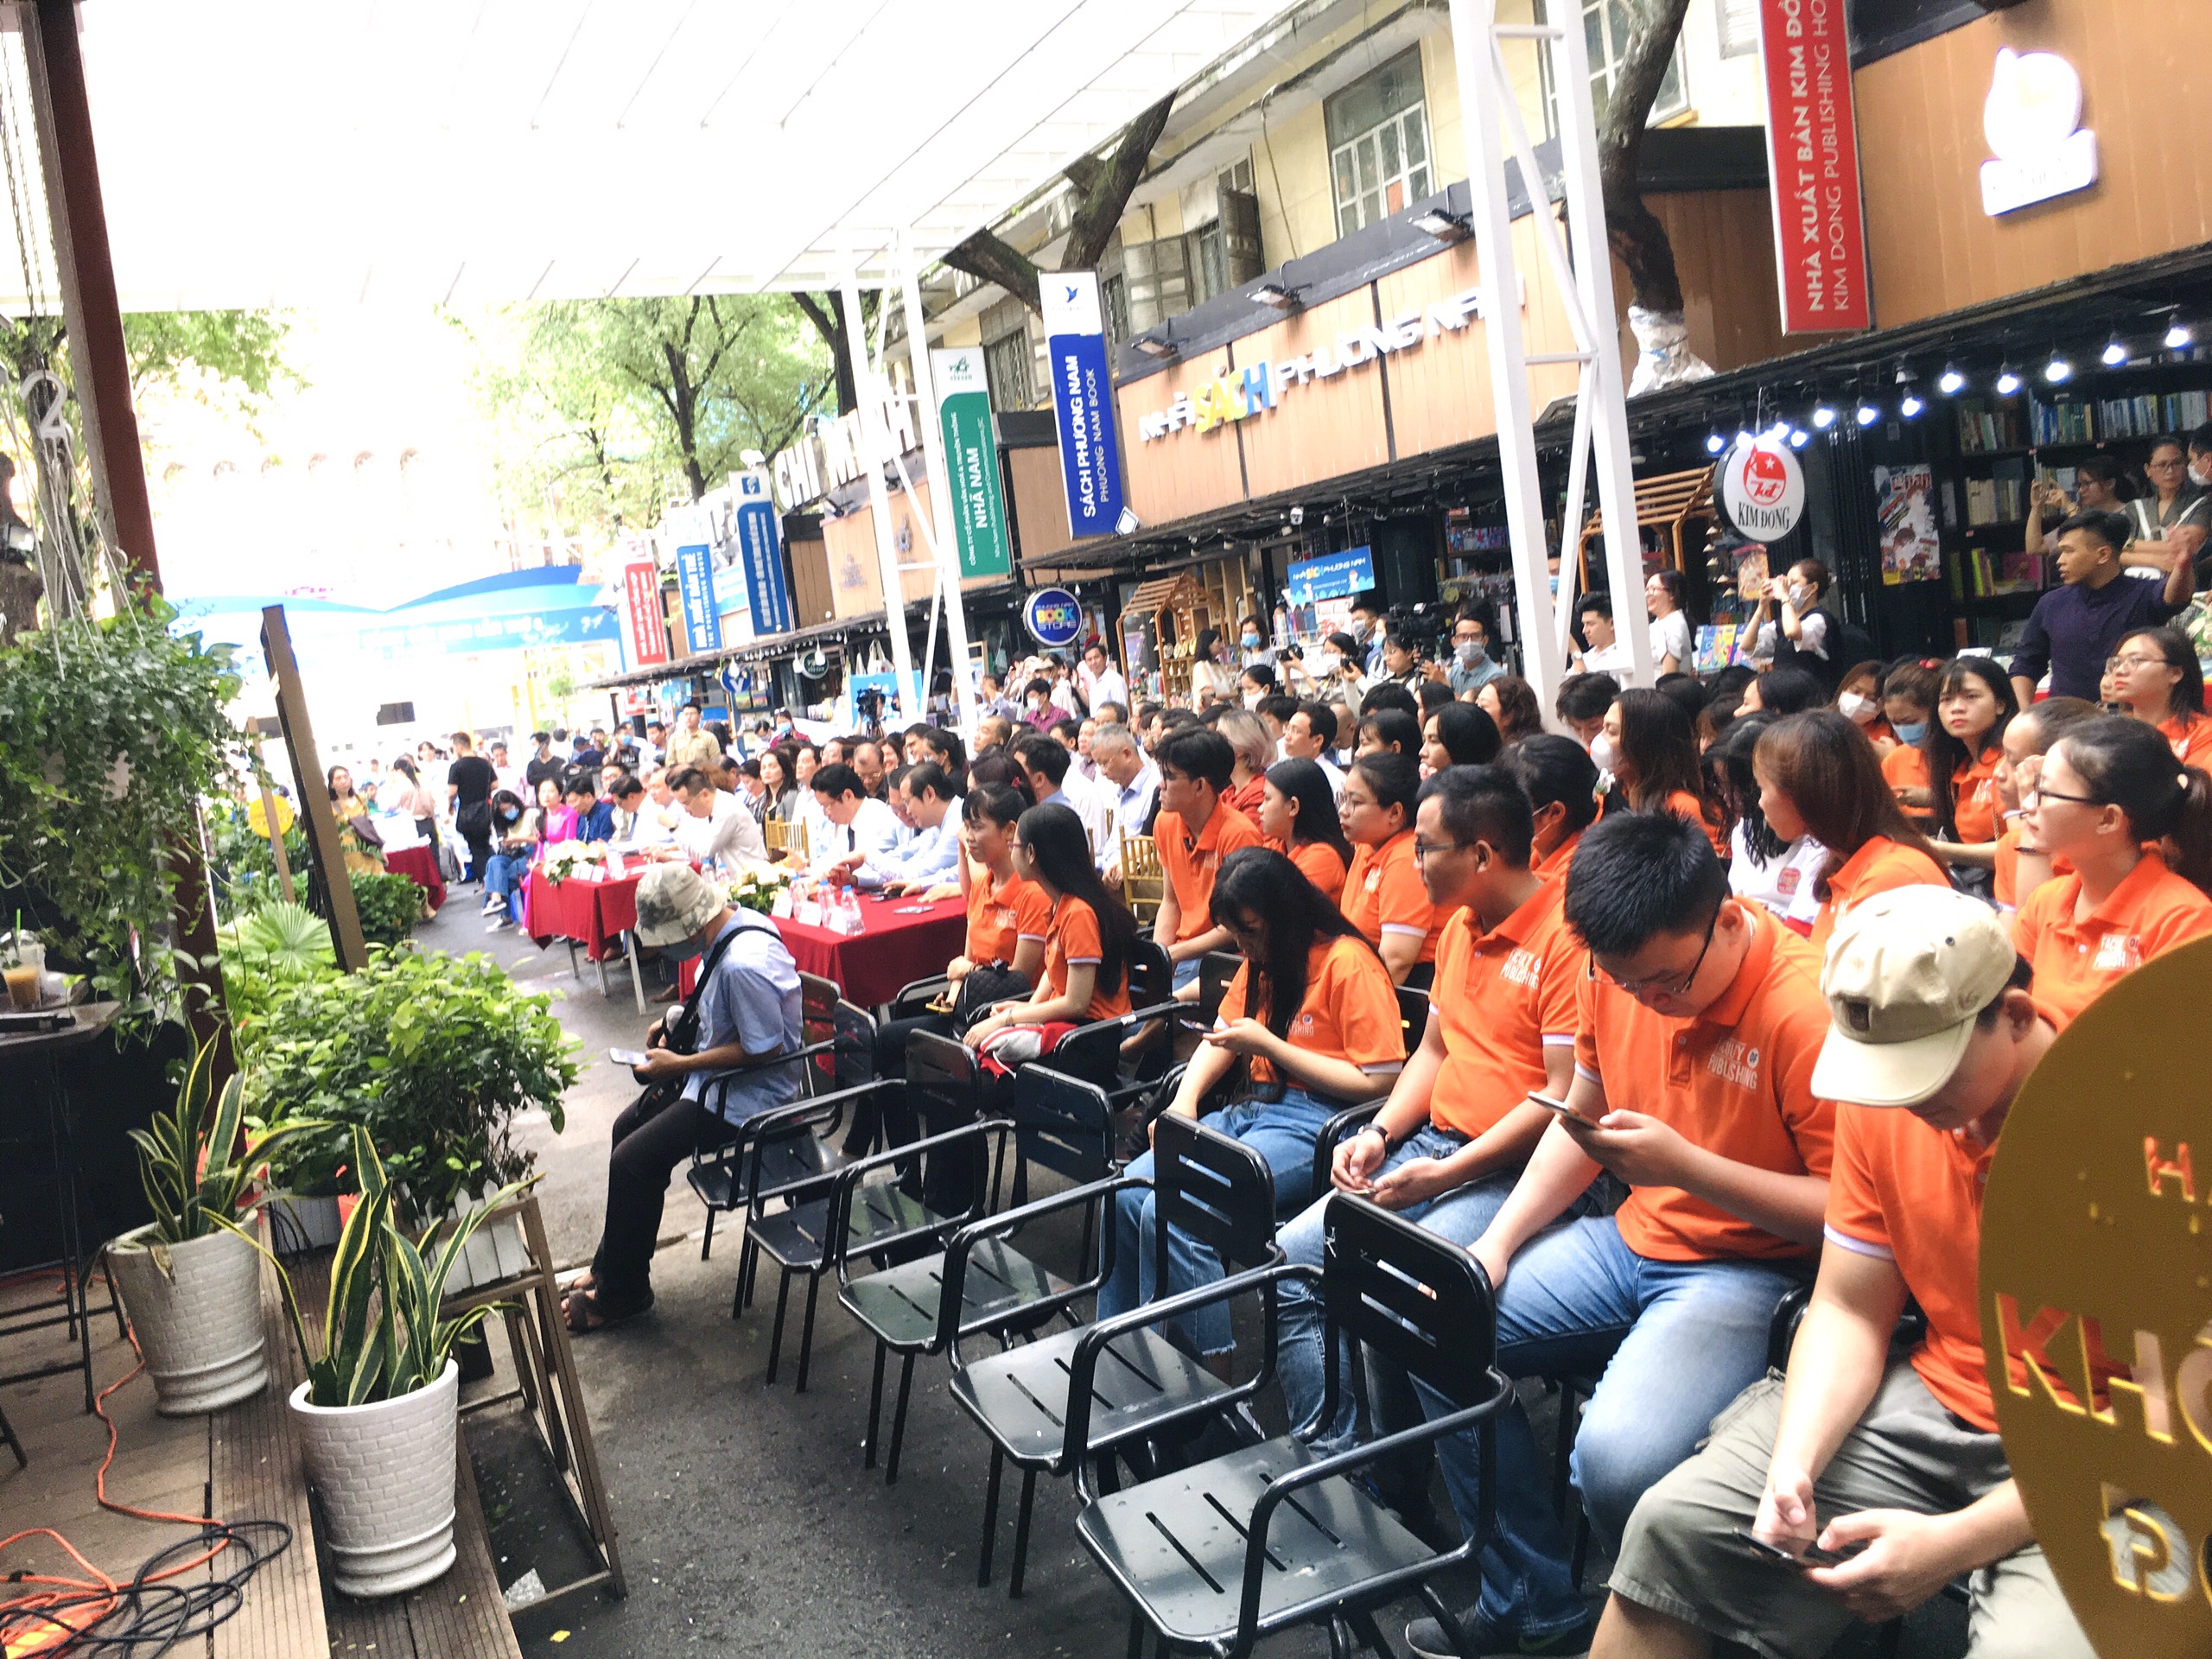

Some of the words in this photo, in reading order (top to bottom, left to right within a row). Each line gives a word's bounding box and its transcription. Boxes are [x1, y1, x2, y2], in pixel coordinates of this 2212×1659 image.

[1788, 45, 1808, 98] KIM
[1789, 105, 1814, 162] BẢN
[1814, 43, 1840, 179] PUBLISHING
[1825, 186, 1846, 261] DONG
[1801, 250, 1824, 312] NHÀ
[1834, 267, 1849, 311] KIM
[1065, 355, 1082, 396] NAM
[1085, 368, 1099, 408] BOOK
[1193, 361, 1278, 434] SÁCH
[1090, 410, 1103, 442] NAM
[966, 448, 982, 488] NAM
[1094, 445, 1109, 503] PHUONG
[1079, 469, 1096, 518] SÁCH
[1738, 501, 1758, 528] KIM
[1036, 607, 1075, 624] BOOK
[1707, 1052, 1758, 1091] PUBLISHING
[2144, 1135, 2212, 1206] H
